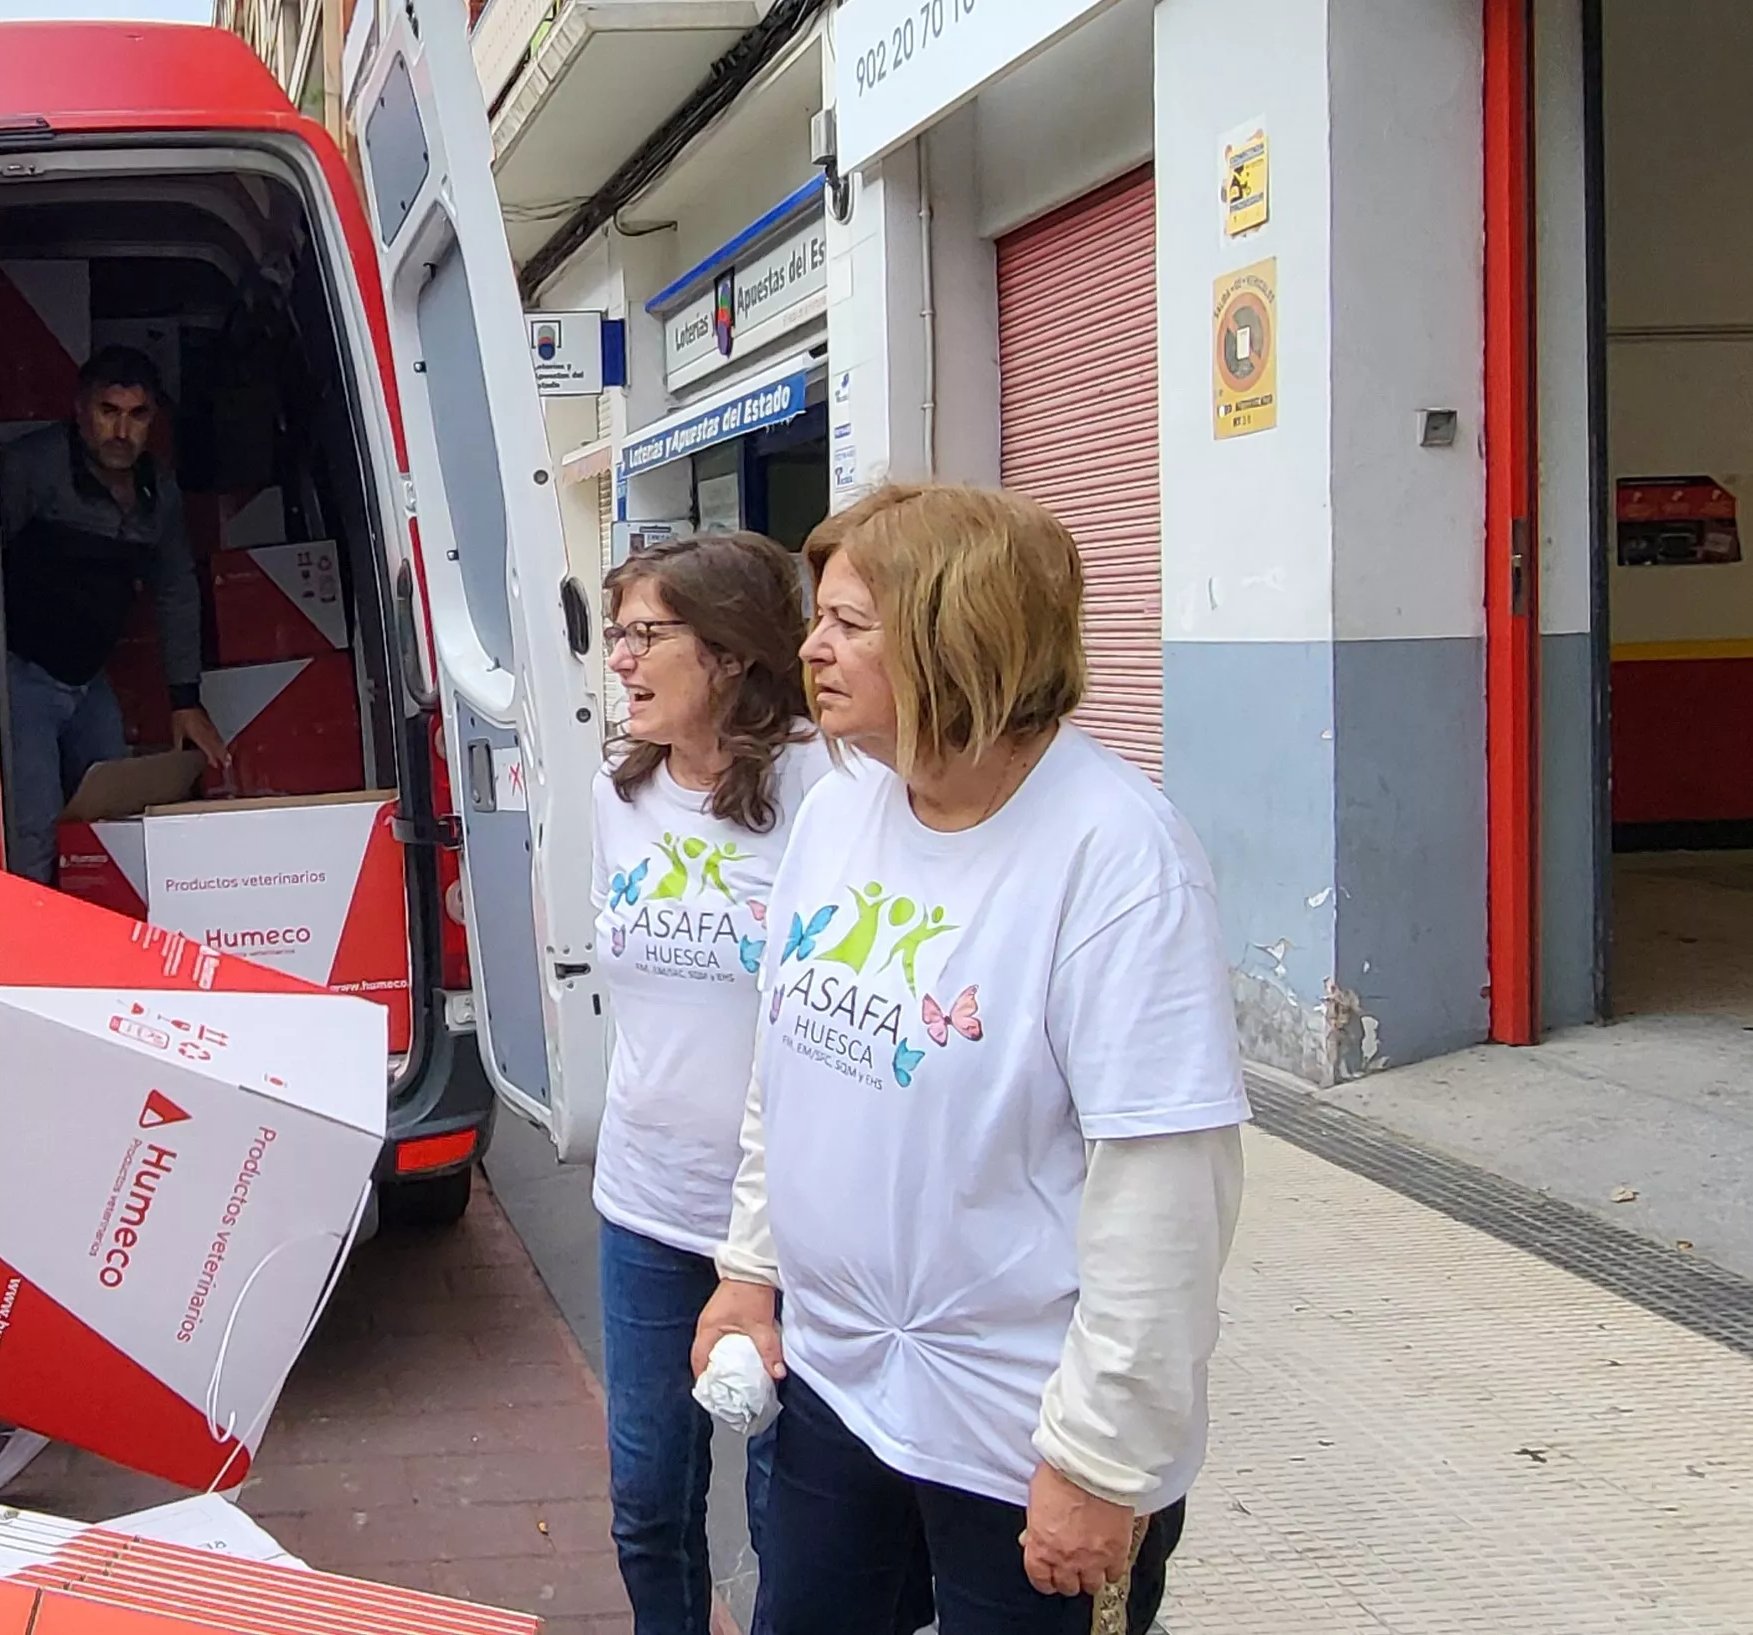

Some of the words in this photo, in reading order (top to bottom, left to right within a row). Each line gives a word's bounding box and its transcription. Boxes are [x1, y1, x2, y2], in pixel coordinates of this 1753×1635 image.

[856, 40, 887, 97] 902
[892, 17, 914, 70] 20
[920, 0, 944, 48] 70
[737, 267, 785, 318] Apuestas
[788, 243, 807, 283] del
[671, 414, 720, 453] Apuestas
[722, 402, 741, 432] del
[744, 385, 791, 424] Estado
[165, 873, 238, 892] Productos
[242, 870, 326, 887] veterinarios
[206, 927, 311, 948] Humeco
[629, 906, 739, 944] ASAFA
[645, 944, 721, 969] HUESCA
[786, 967, 902, 1045] ASAFA
[794, 1015, 873, 1069] HUESCA
[112, 1137, 143, 1193] Productos
[223, 1126, 277, 1227] Productos
[89, 1195, 117, 1257] veterinarios
[99, 1143, 178, 1288] Humeco
[176, 1231, 232, 1343] veterinarios
